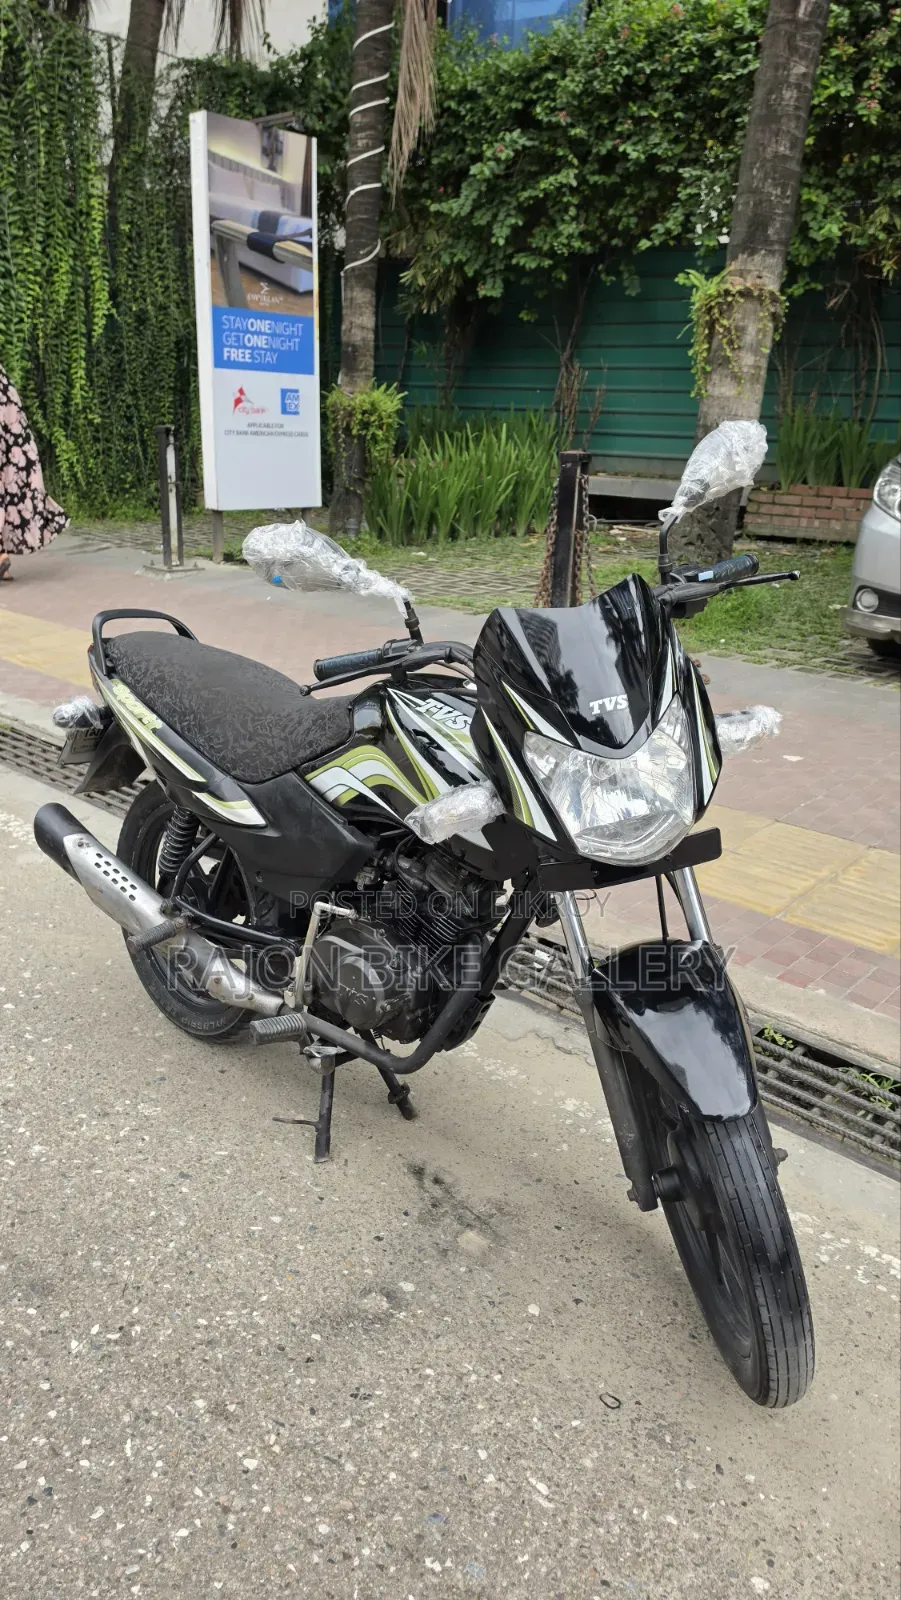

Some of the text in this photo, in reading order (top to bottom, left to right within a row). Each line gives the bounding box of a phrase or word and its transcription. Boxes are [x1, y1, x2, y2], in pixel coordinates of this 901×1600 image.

[223, 347, 279, 365] FREE STAY
[415, 697, 473, 731] TVS
[588, 694, 629, 716] TVS
